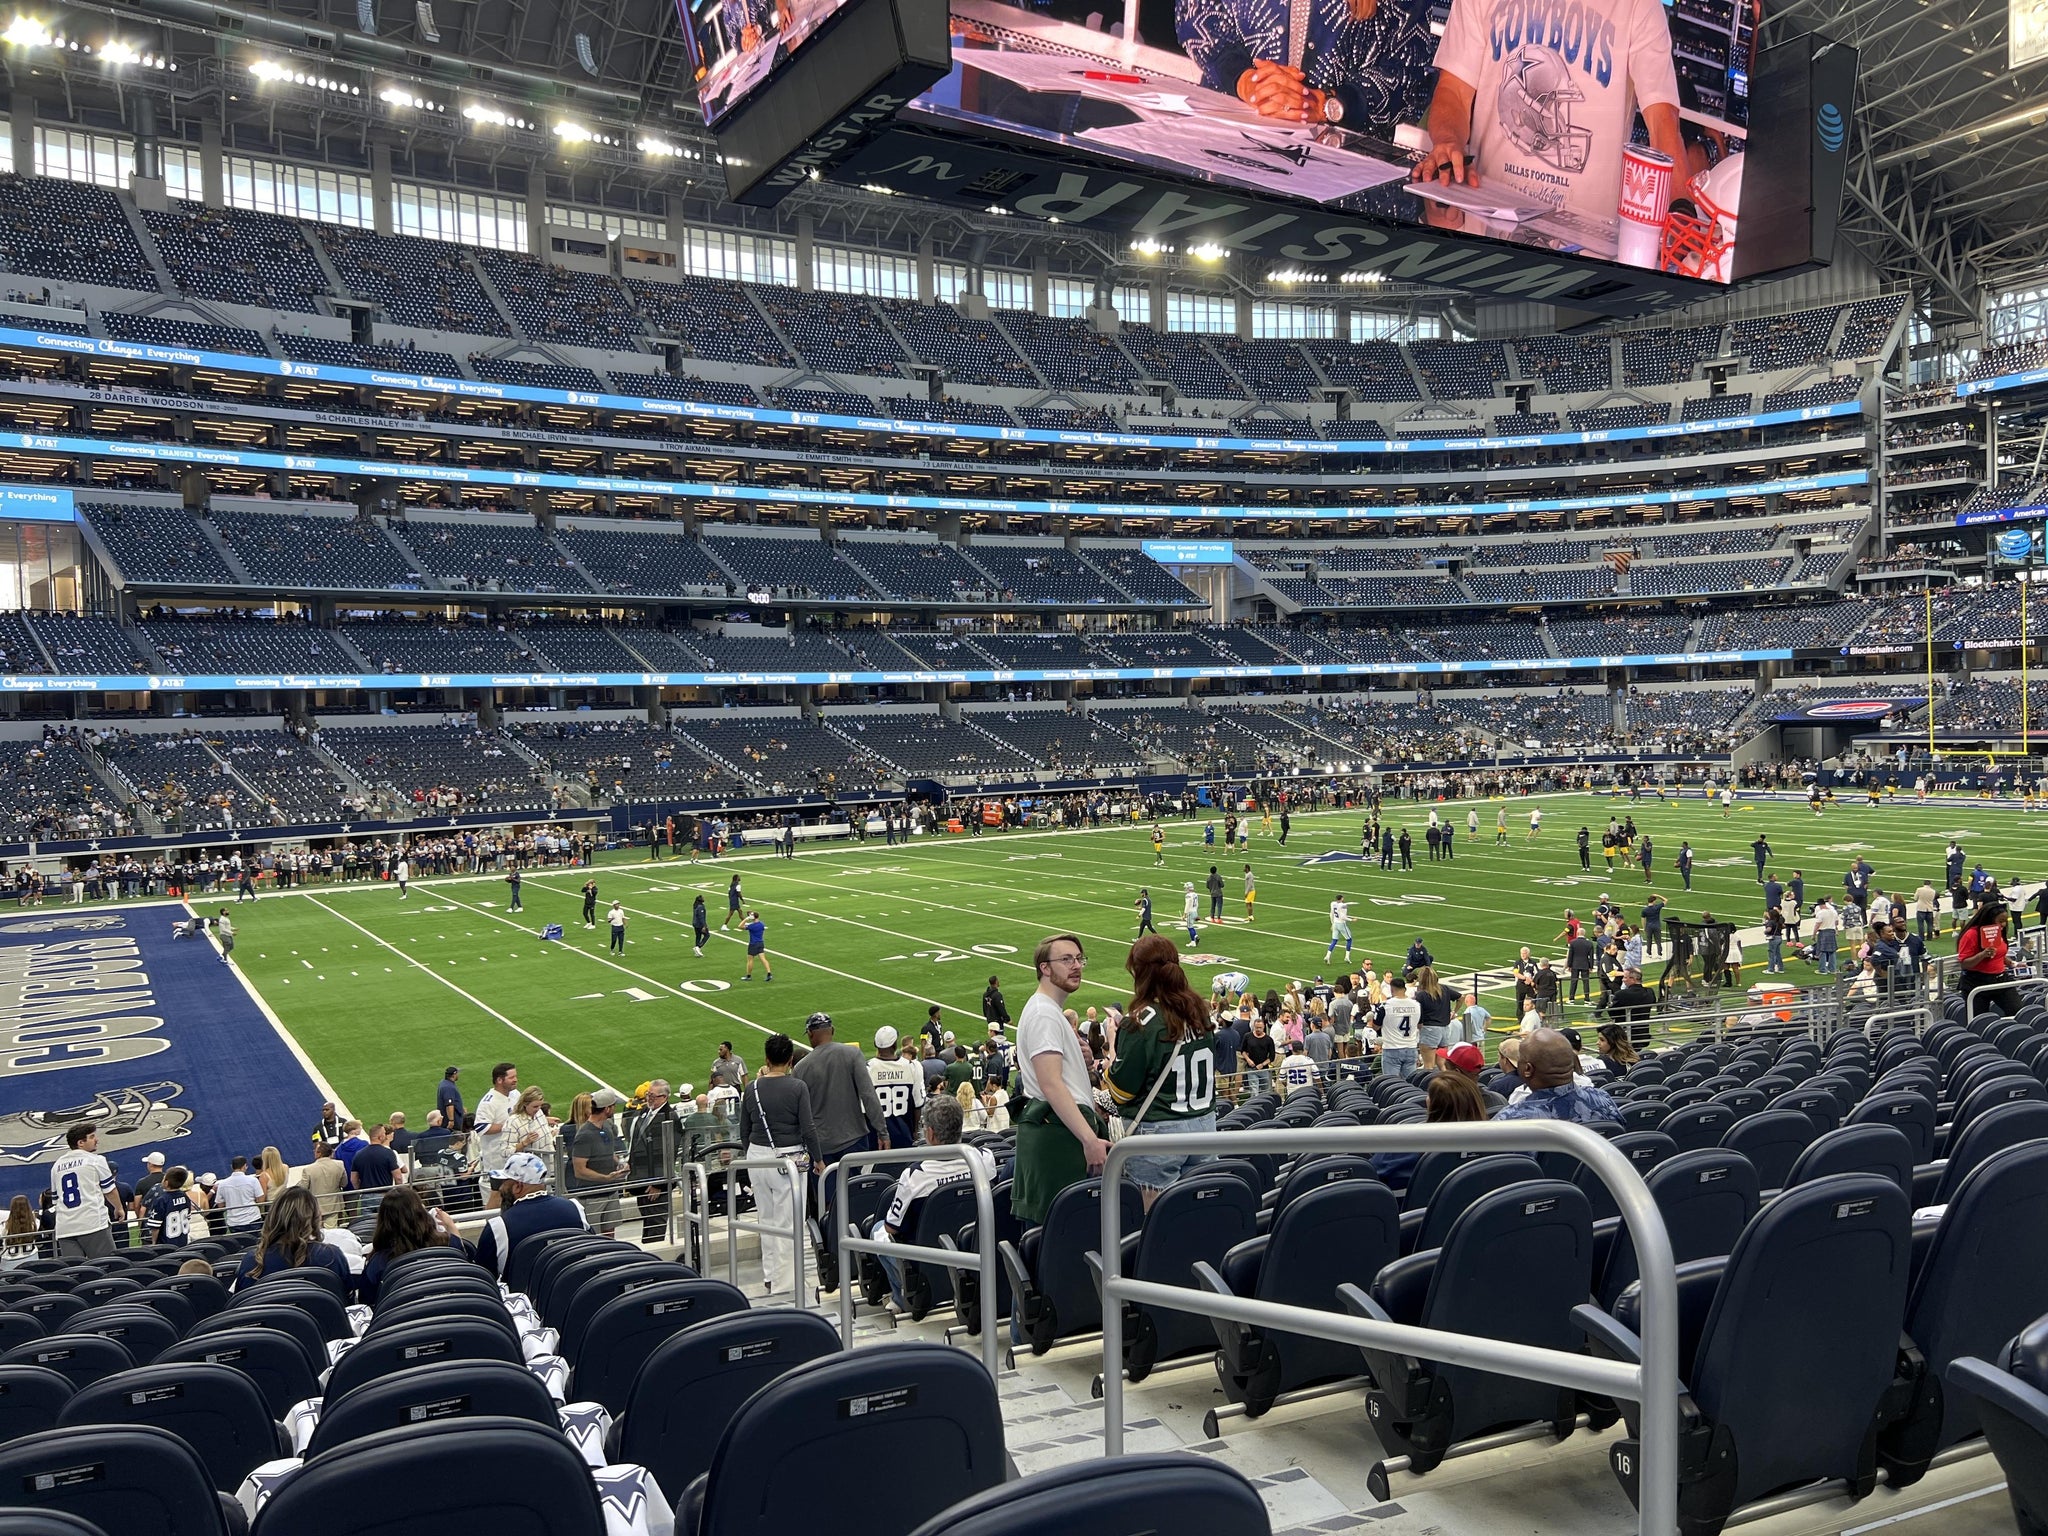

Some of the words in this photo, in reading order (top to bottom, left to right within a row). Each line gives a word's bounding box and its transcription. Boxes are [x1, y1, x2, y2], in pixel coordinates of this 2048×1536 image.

[1490, 0, 1616, 88] COWBOYS
[766, 93, 906, 188] WINSTAR
[1504, 163, 1529, 178] DALLAS
[1531, 171, 1570, 187] FOOTBALL
[1015, 172, 1597, 299] WINSTAR
[37, 335, 95, 351] Connecting
[98, 336, 143, 358] Changes
[147, 349, 201, 363] Everything
[294, 366, 319, 376] AT&T
[371, 374, 418, 388] Connecting
[420, 377, 457, 392] Changes
[459, 383, 503, 396] Everything
[90, 391, 101, 400] 28
[105, 392, 148, 404] DARREN
[151, 397, 204, 409] WOODSON
[579, 395, 600, 404] AT&T
[642, 401, 682, 413] Connecting
[717, 408, 754, 419] Everything
[1812, 406, 1832, 416] AT&T
[315, 413, 327, 421] 94
[329, 415, 370, 425] CHARLES
[371, 418, 400, 428] HALEY
[801, 415, 820, 423] AT&T
[857, 420, 892, 430] Connecting
[923, 426, 956, 435] Everything
[1647, 425, 1683, 436] Connecting
[1717, 418, 1754, 428] Everything
[35, 438, 59, 448] AT&T
[512, 431, 546, 441] MICHAEL
[548, 434, 568, 442] IRVIN
[1060, 433, 1091, 442] Connecting
[1119, 436, 1150, 445] Everything
[1508, 438, 1542, 447] Everything
[1591, 432, 1608, 440] AT&T
[684, 444, 711, 453] AIKMAN
[1308, 443, 1338, 451] Everything
[1393, 442, 1409, 450] AT&T
[109, 444, 156, 457] Connecting
[197, 451, 240, 463] Everything
[805, 454, 831, 462] EMMITT
[296, 459, 317, 468] AT&T
[359, 464, 398, 475] Connecting
[432, 470, 469, 480] Everything
[523, 475, 540, 483] AT&T
[577, 479, 611, 489] Connecting
[641, 483, 673, 493] Everything
[7, 491, 57, 503] Everything
[1678, 492, 1694, 500] AT&T
[1966, 515, 1996, 523] American
[2014, 509, 2045, 517] American
[1850, 645, 1913, 655] Blockchain.com
[3, 677, 44, 691] Changes
[47, 679, 97, 689] Everything
[162, 679, 185, 687] AT&T
[235, 678, 280, 688] Connecting
[282, 675, 317, 688] Changes
[319, 678, 361, 687] Everything
[492, 677, 529, 685] Connecting
[562, 676, 598, 684] Everything
[652, 675, 669, 683] AT&T
[913, 944, 1018, 962] 20
[612, 979, 731, 1002] 10
[1399, 1016, 1410, 1036] 4
[877, 1071, 904, 1081] BRYANT
[972, 1066, 983, 1080] 10
[1171, 1047, 1213, 1112] 10
[1288, 1069, 1307, 1085] 25
[876, 1085, 909, 1118] 88
[57, 1159, 83, 1172] AIKMAN
[61, 1172, 81, 1208] 8
[1369, 1399, 1379, 1418] 15
[1616, 1452, 1631, 1475] 16
